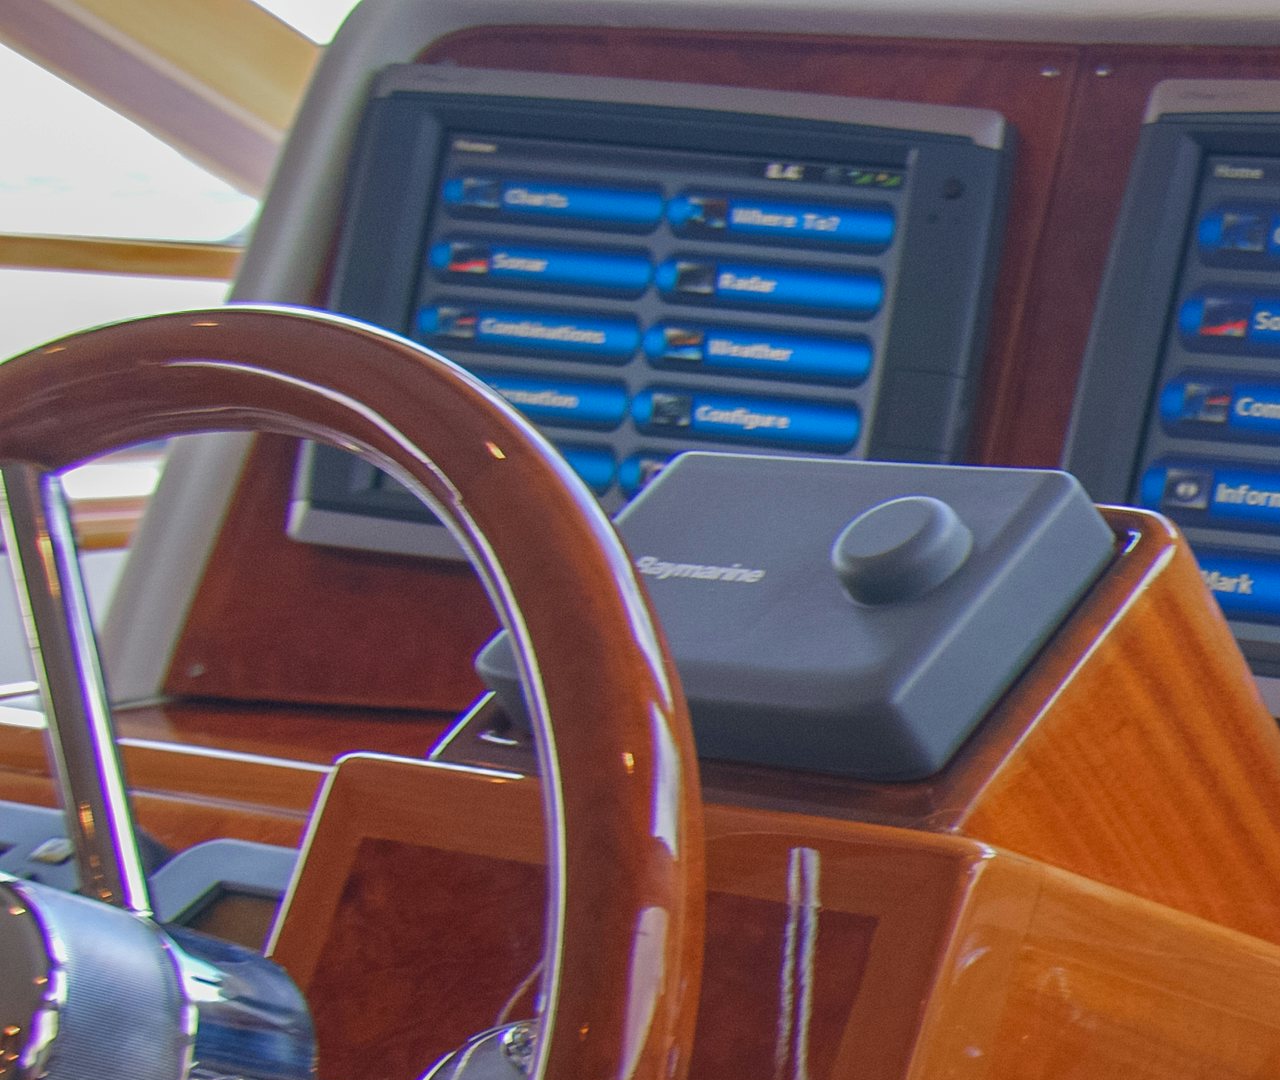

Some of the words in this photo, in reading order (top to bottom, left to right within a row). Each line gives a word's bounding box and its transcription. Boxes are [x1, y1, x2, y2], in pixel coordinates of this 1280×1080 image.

[504, 188, 569, 209] Charts
[731, 208, 798, 228] Where
[802, 213, 841, 232] To?
[492, 252, 548, 272] Sonar
[717, 272, 778, 293] Radar
[480, 317, 607, 344] Combinations
[707, 338, 794, 362] Weather
[695, 405, 791, 430] Configure
[635, 556, 766, 583] Raymarine
